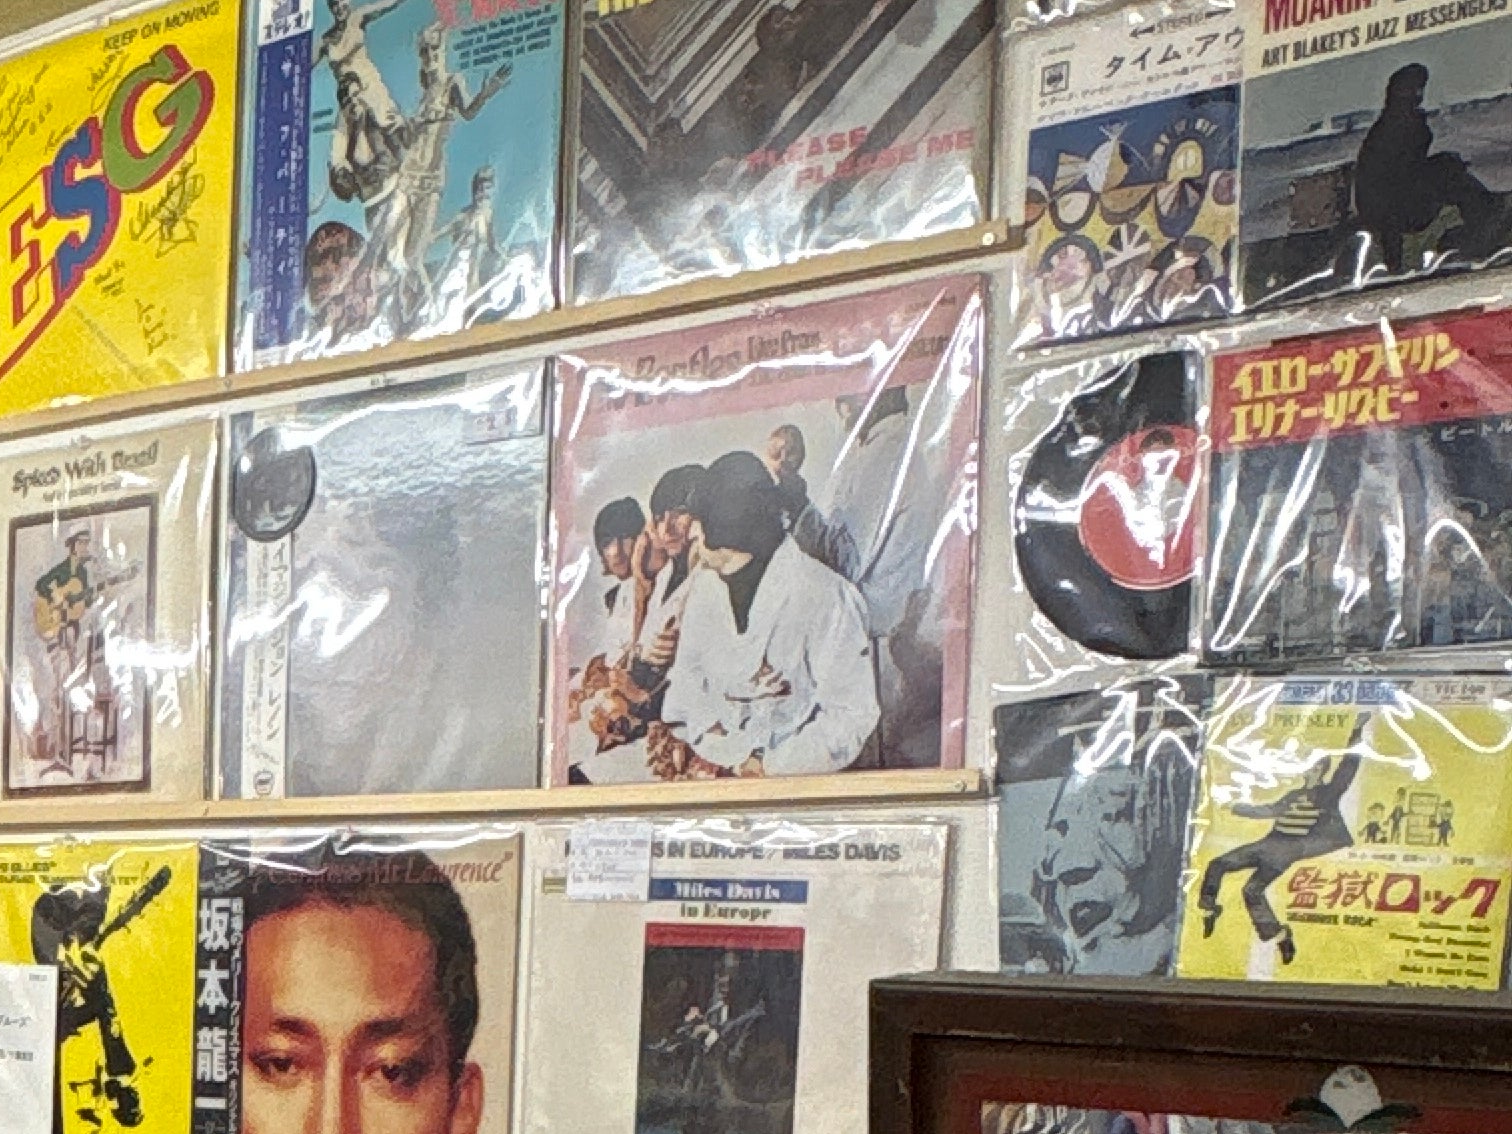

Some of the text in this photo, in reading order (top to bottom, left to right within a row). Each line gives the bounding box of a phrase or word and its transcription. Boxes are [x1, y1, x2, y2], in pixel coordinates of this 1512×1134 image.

[103, 2, 220, 52] KEEP ON MOVING
[1261, 44, 1290, 68] ART
[1293, 25, 1361, 61] BLAKEY'S
[1365, 16, 1400, 44] JAZZ
[746, 126, 868, 169] PLEASE
[928, 127, 975, 154] ME
[666, 841, 684, 858] IN
[845, 842, 902, 861] DAVIS
[673, 880, 782, 901] Miles Davis
[1287, 867, 1501, 919] 監獄ロック
[702, 904, 774, 922] Europe
[195, 897, 232, 1110] 坂本龍一
